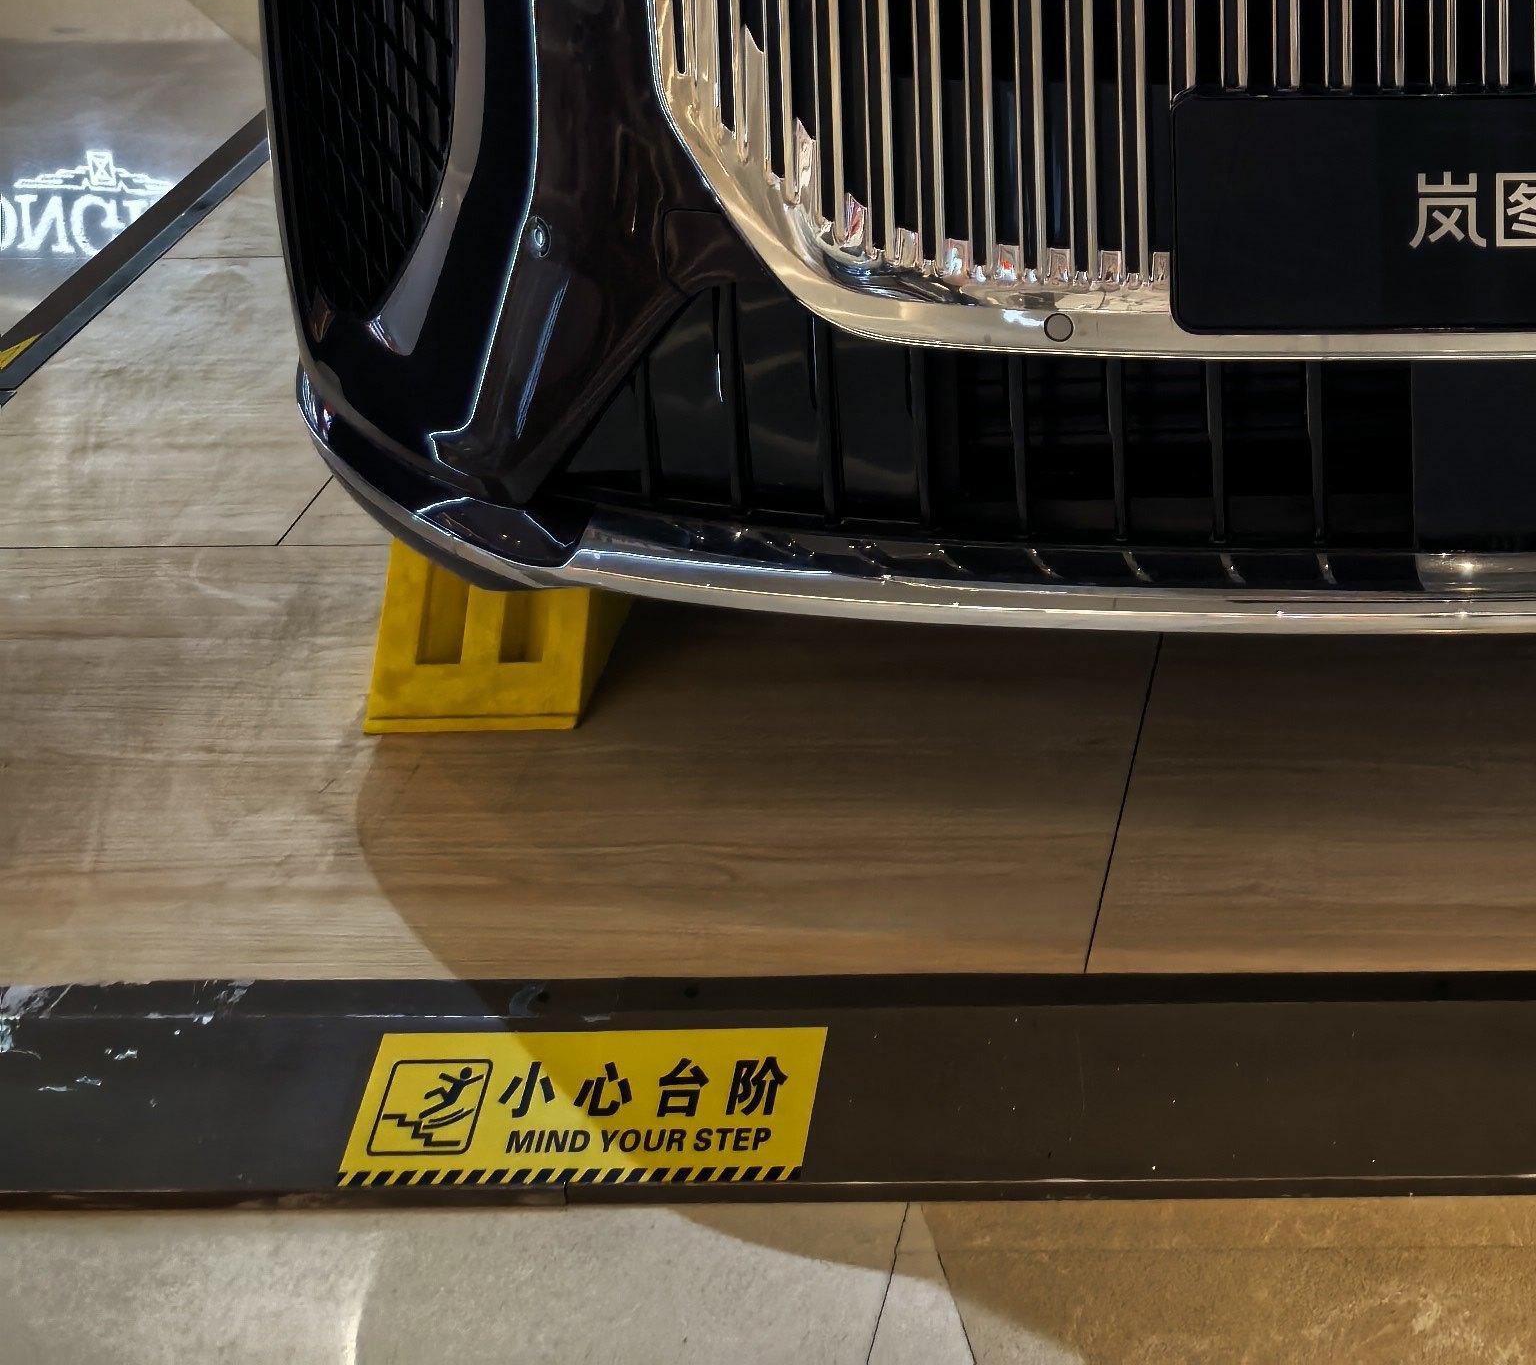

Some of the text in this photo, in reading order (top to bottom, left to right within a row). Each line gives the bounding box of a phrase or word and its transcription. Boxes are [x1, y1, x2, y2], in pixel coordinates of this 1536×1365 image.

[497, 1055, 789, 1118] 小心台阶
[504, 1127, 772, 1155] MIND YOUR STEP
